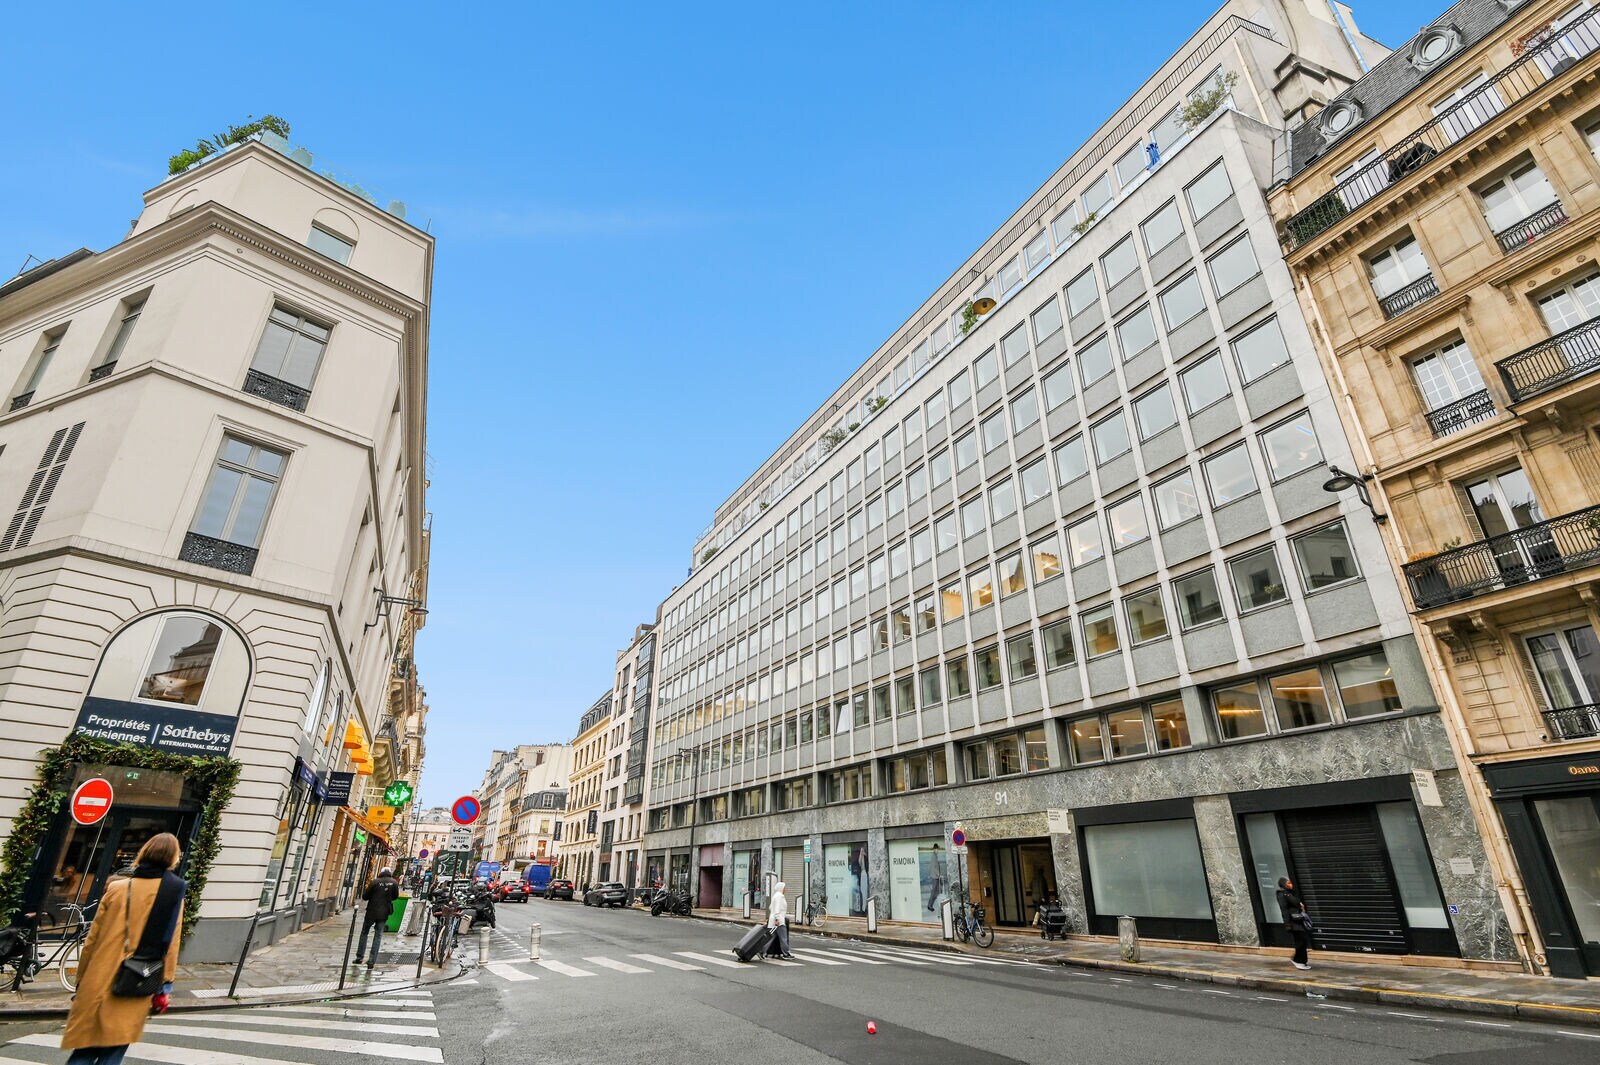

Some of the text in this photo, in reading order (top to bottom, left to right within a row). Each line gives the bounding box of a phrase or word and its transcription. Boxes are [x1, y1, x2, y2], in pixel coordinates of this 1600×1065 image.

[87, 714, 151, 731] Propriétés
[76, 726, 147, 743] Parisiennes
[161, 724, 231, 745] Sotheby's
[158, 739, 228, 752] INTERNATIONAL REALTY
[994, 791, 1008, 806] 91
[828, 859, 846, 867] RIMOWA
[893, 857, 916, 866] RIMOWA
